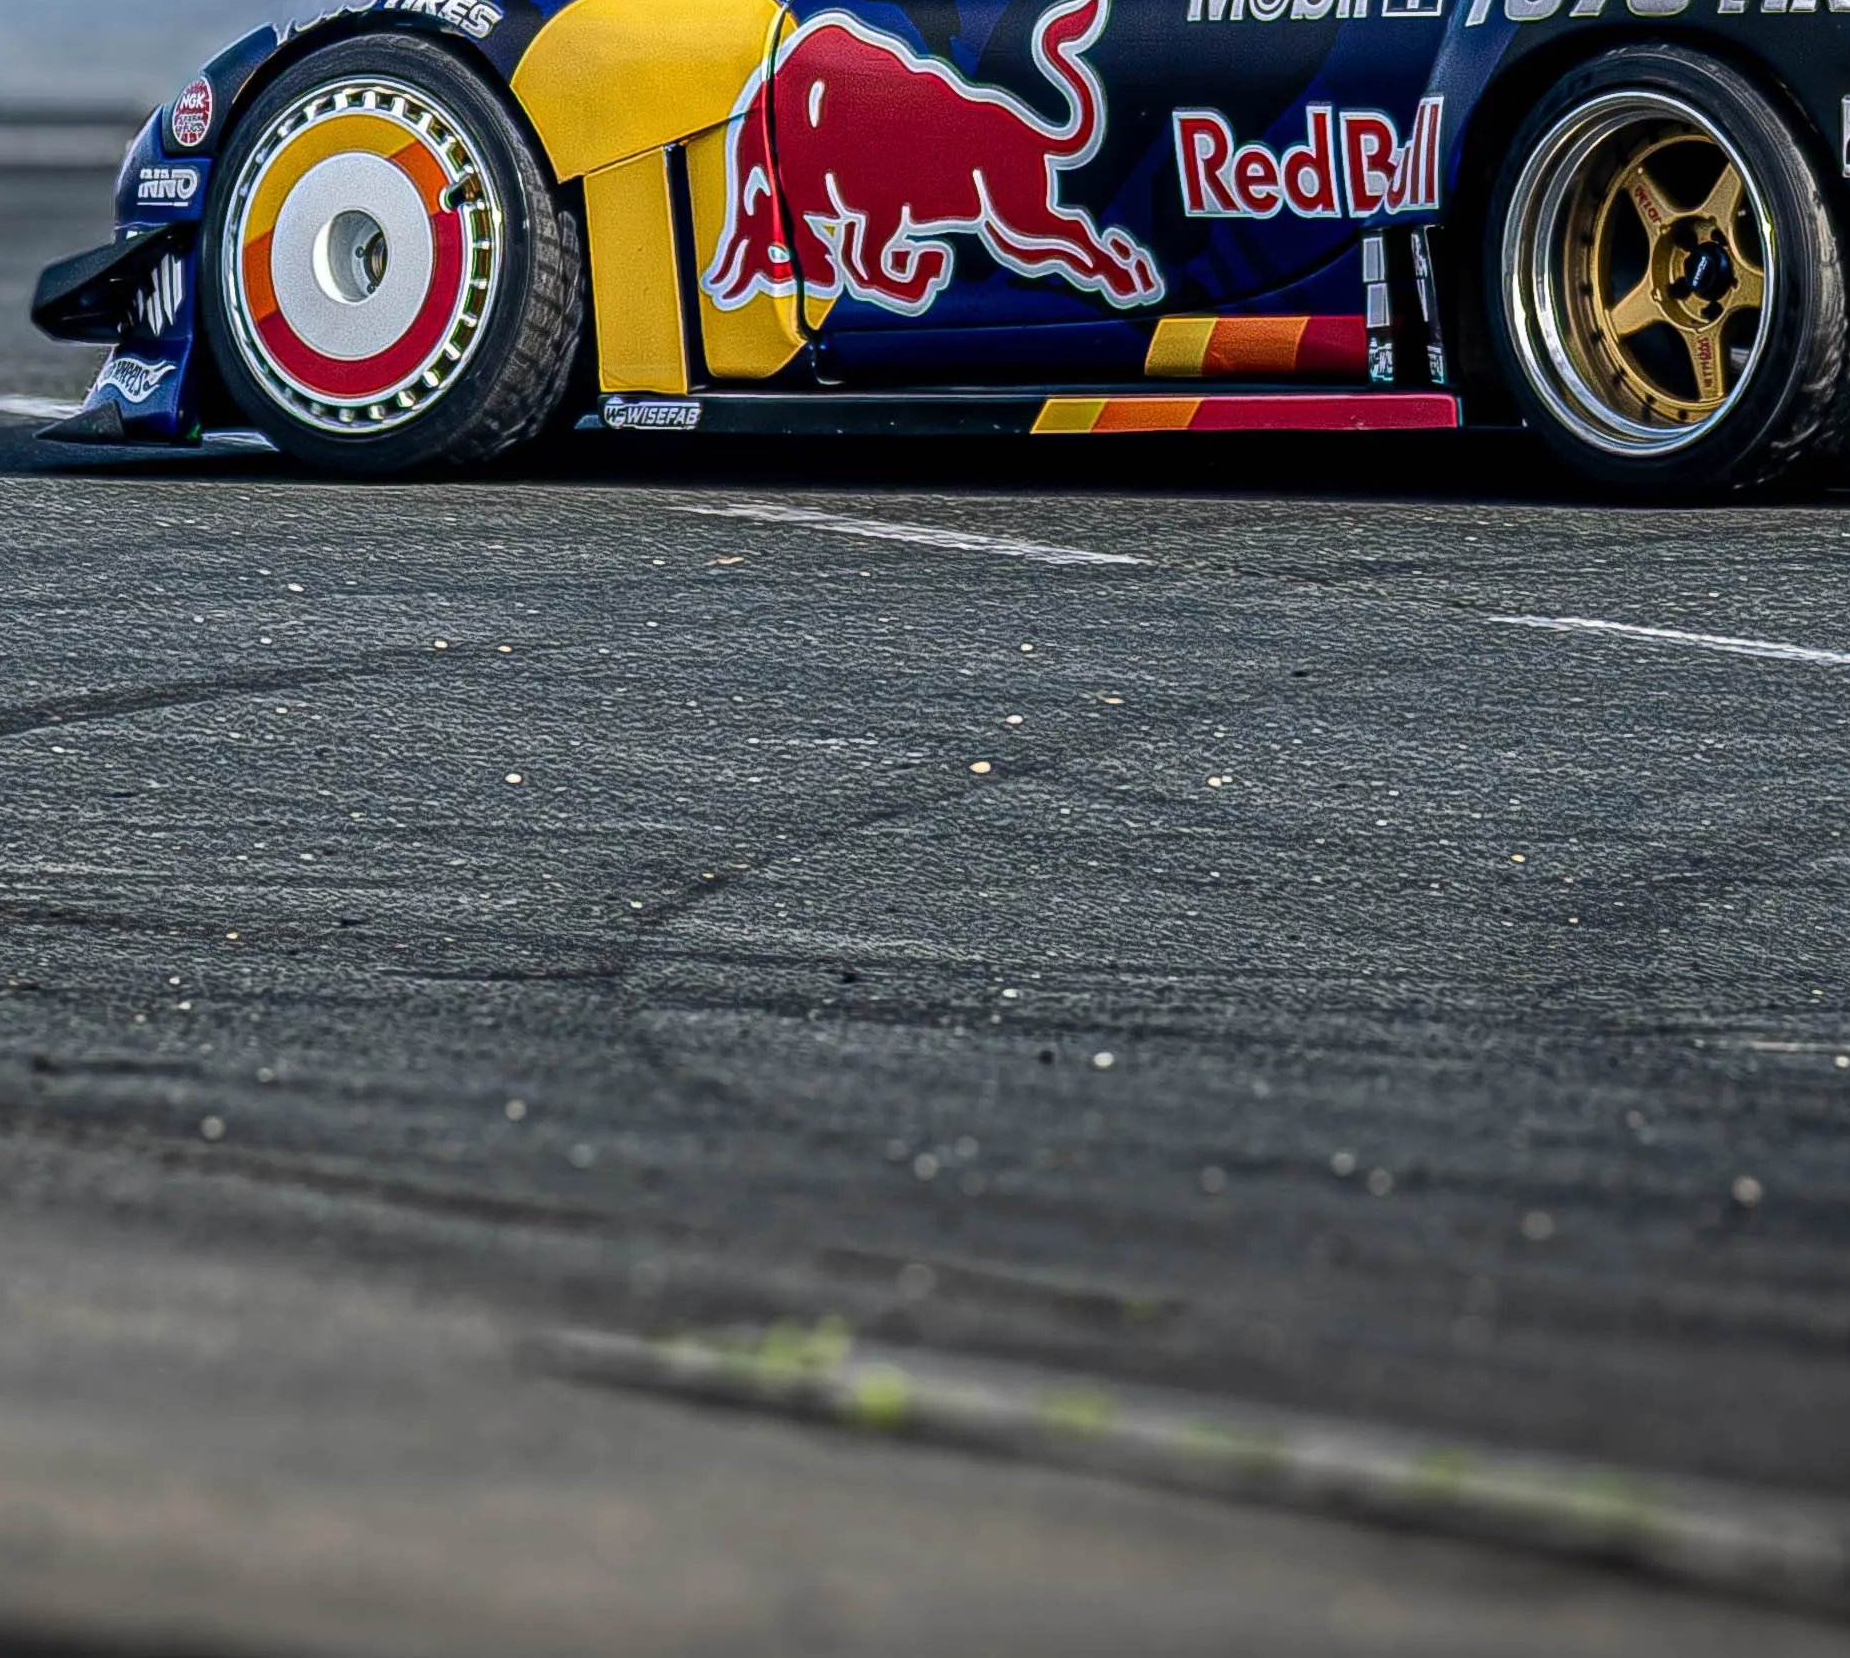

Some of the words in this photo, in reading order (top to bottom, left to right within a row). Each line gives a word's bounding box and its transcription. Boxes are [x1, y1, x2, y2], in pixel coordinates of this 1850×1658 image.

[180, 92, 206, 110] NGK
[1172, 105, 1342, 219] Red
[1339, 96, 1445, 218] Bull
[627, 407, 701, 425] WISEFAB
